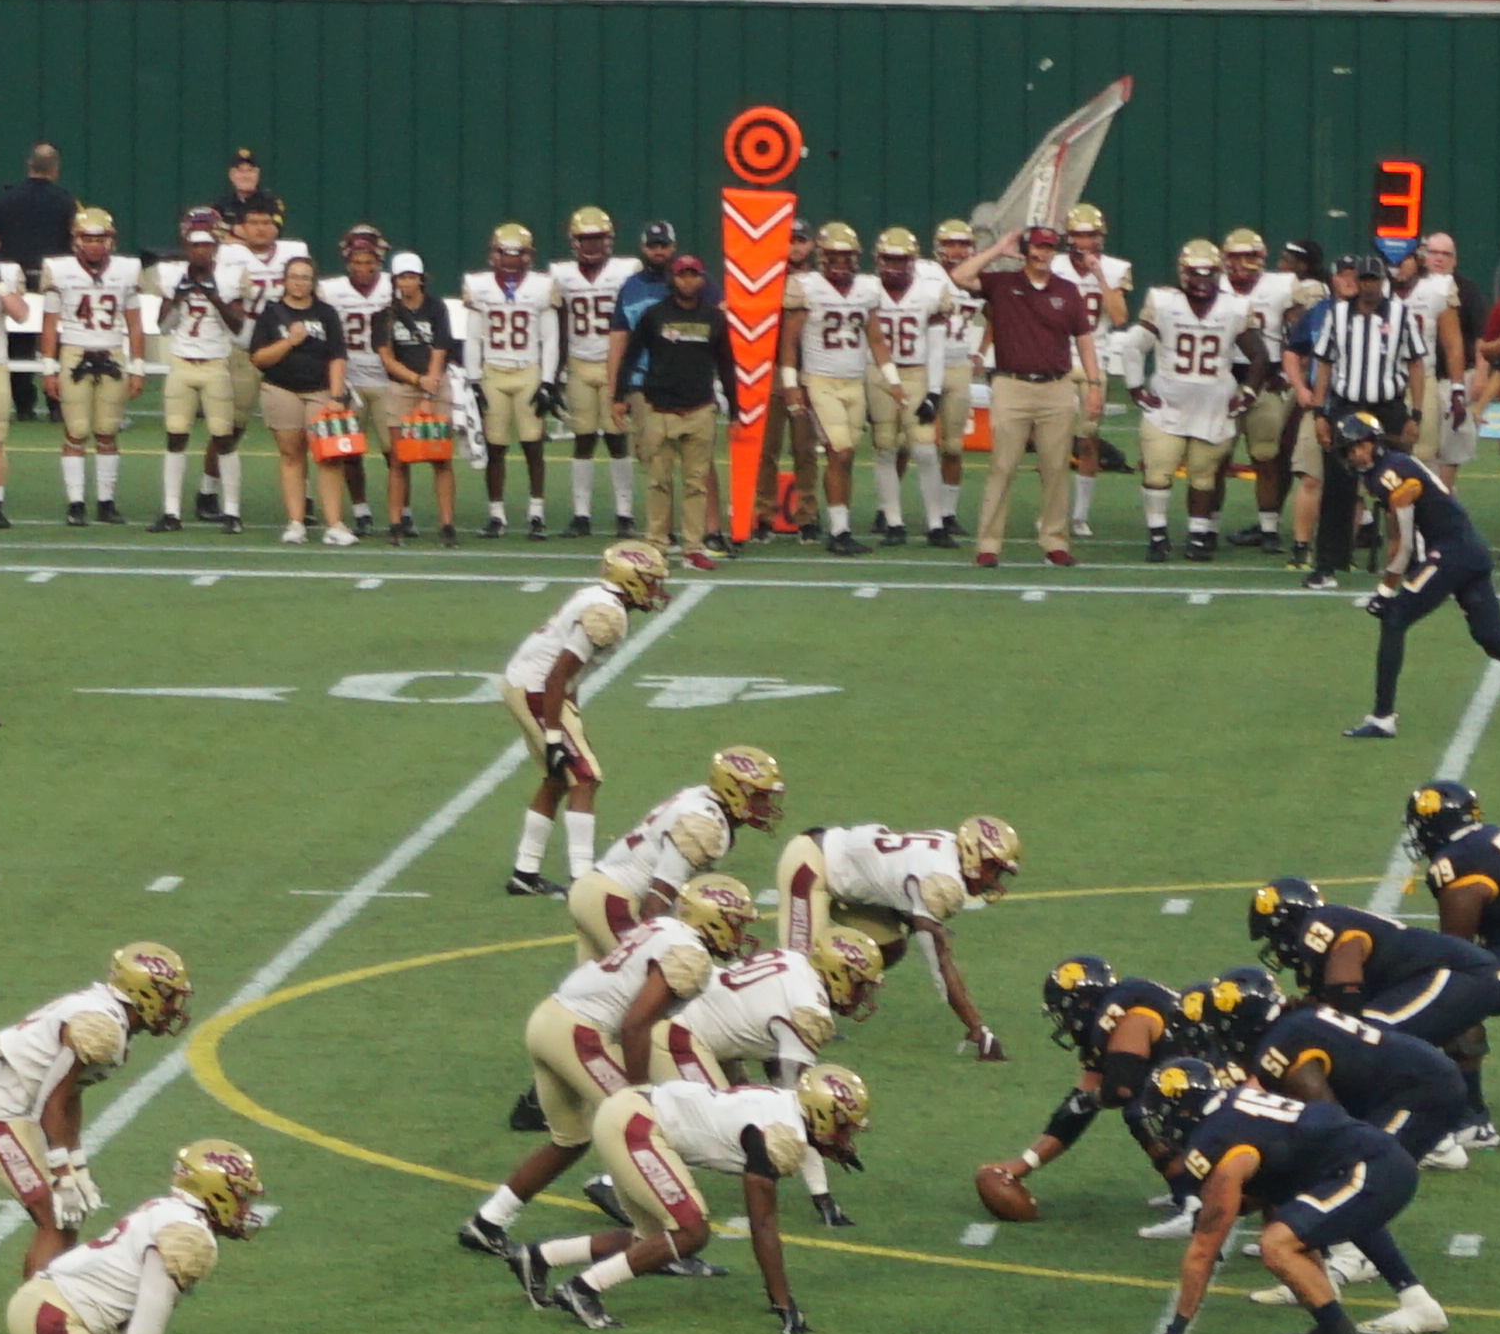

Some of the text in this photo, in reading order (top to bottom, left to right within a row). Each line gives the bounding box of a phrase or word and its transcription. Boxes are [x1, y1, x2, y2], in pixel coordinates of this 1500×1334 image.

[1377, 161, 1422, 240] 3
[76, 292, 123, 331] 43
[188, 305, 207, 338] 7
[488, 310, 529, 351] 28
[570, 295, 612, 335] 85
[822, 311, 863, 349] 23
[1175, 332, 1219, 376] 92
[336, 436, 352, 453] G
